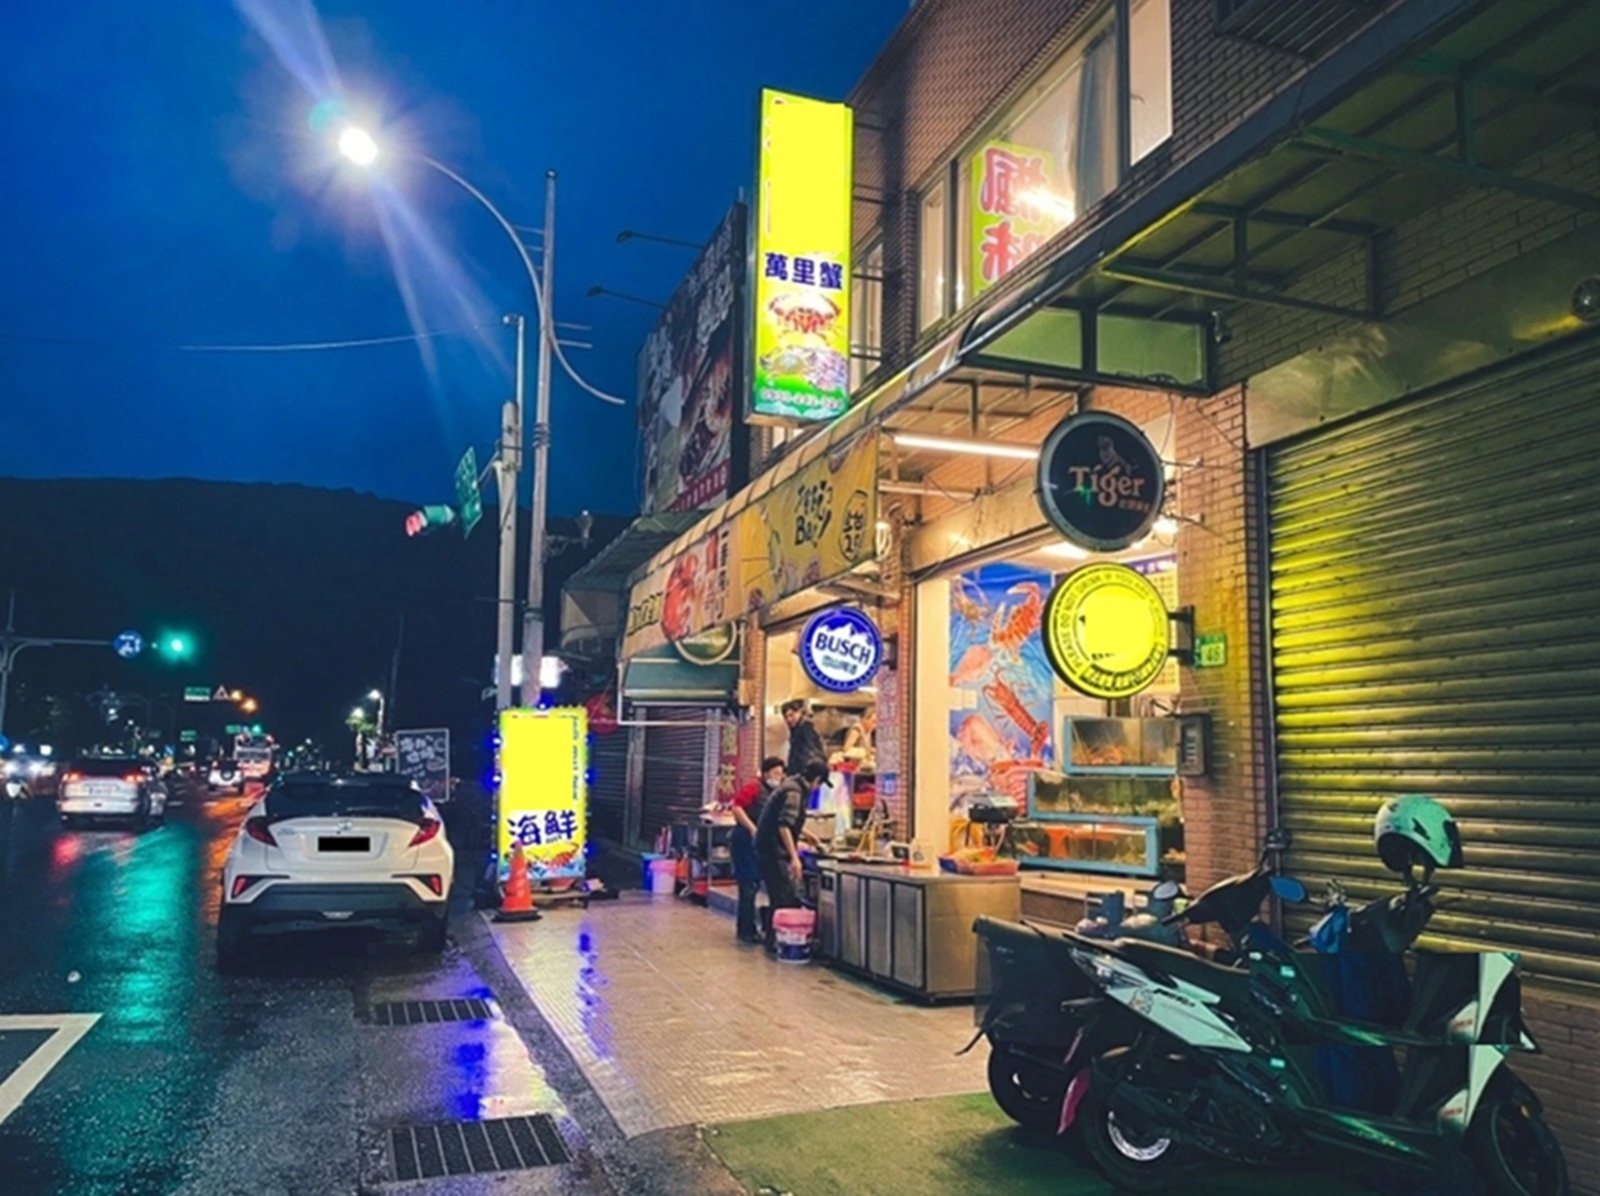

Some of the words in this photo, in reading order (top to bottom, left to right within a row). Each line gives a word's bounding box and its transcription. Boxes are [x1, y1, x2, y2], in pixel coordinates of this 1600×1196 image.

[765, 252, 842, 290] 萬里蟹
[1068, 465, 1145, 507] Tiger
[815, 632, 872, 666] BUSCH
[507, 810, 579, 849] 海鮮
